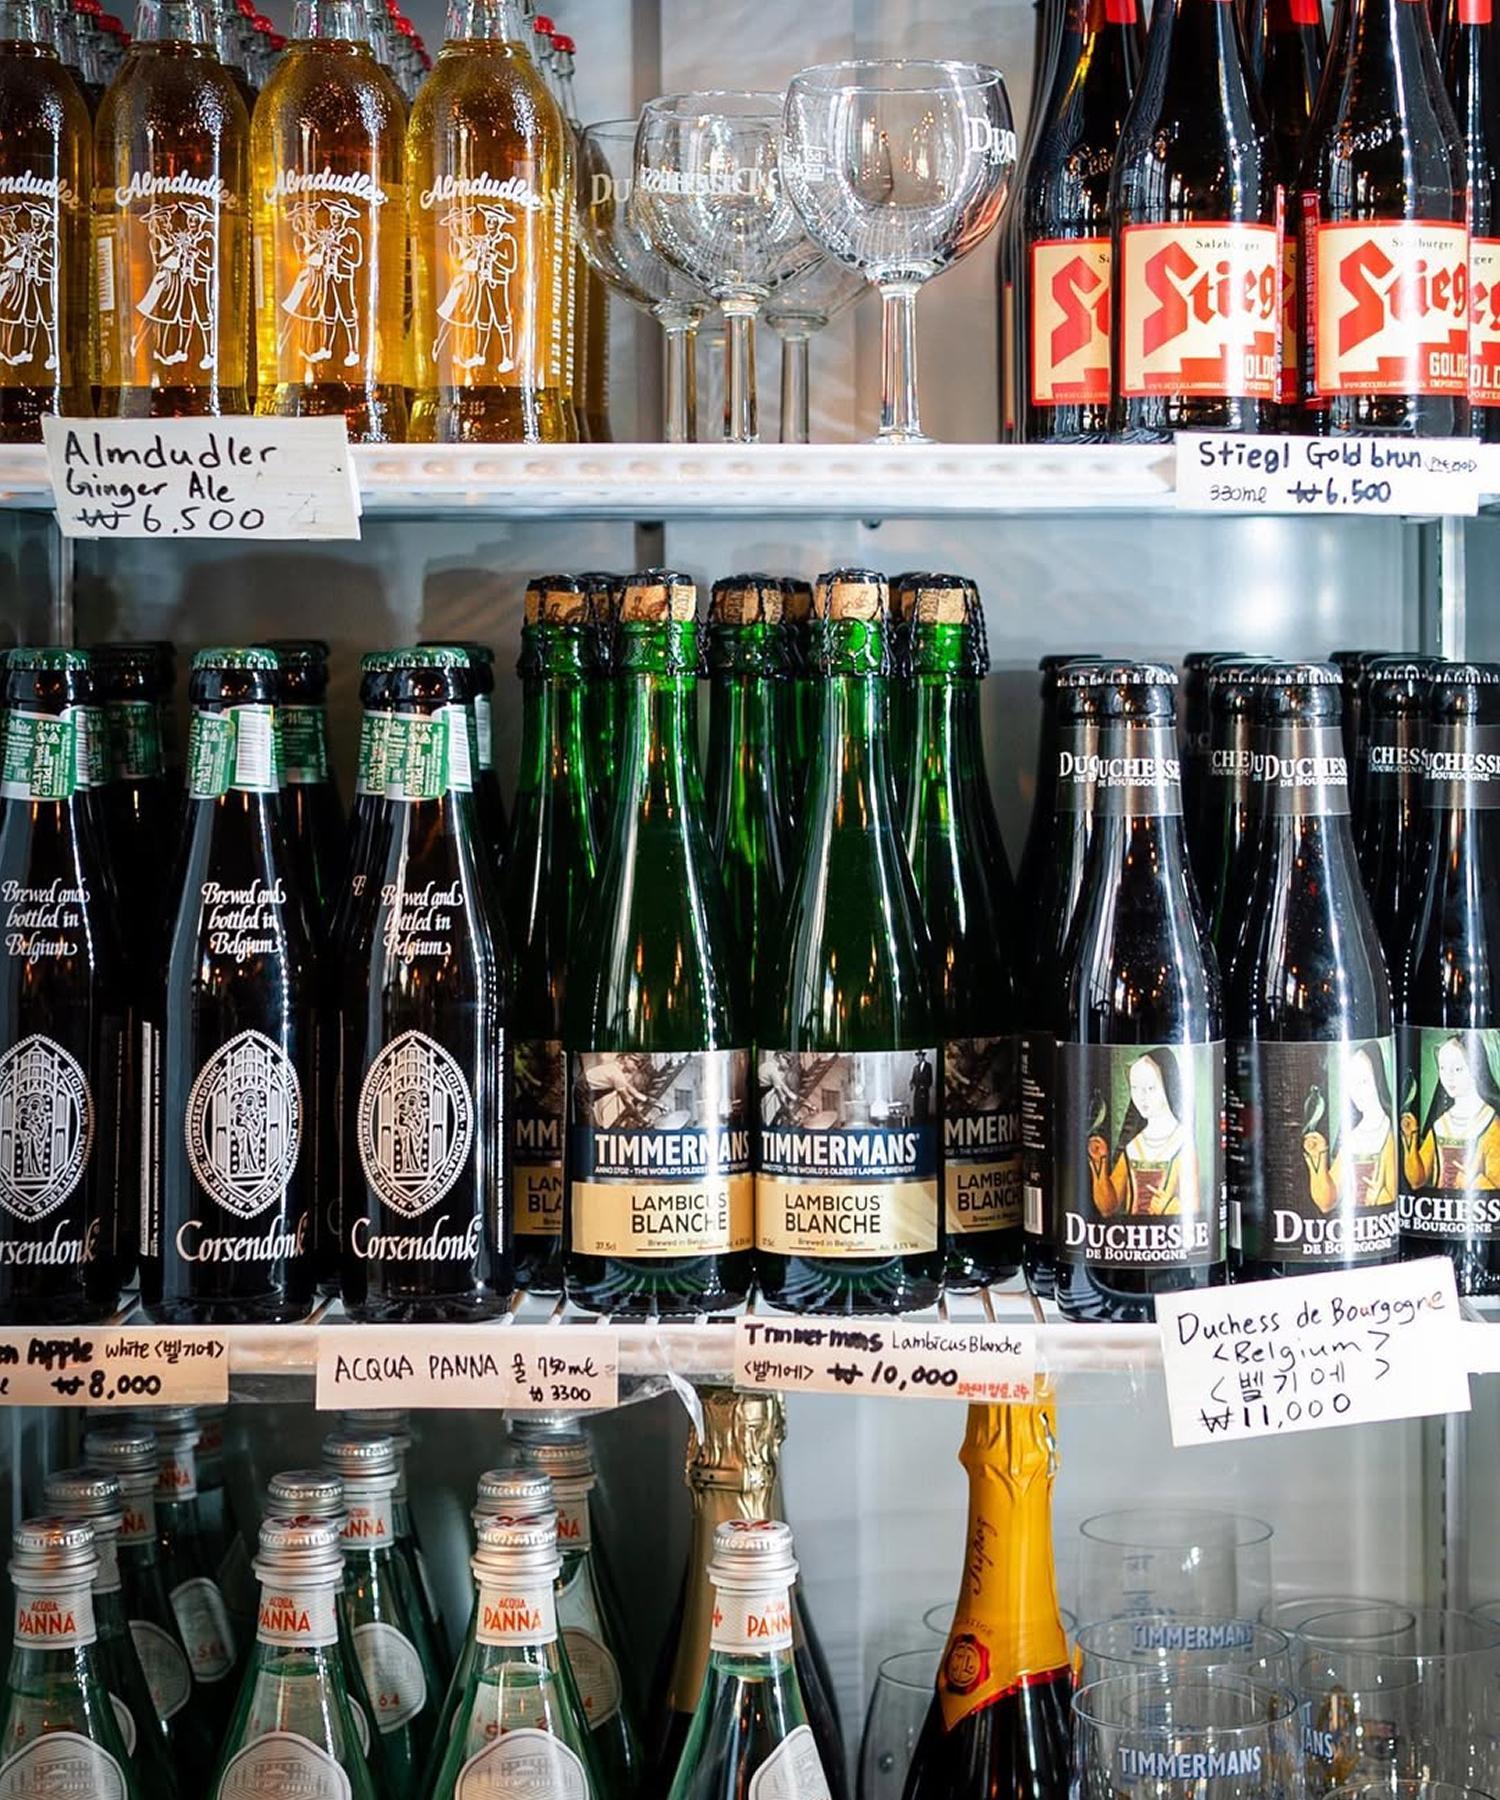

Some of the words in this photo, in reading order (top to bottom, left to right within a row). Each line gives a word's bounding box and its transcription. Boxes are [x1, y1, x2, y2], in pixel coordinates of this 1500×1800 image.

[65, 431, 278, 468] Almdudler
[1199, 441, 1289, 473] Stiegl
[1306, 442, 1361, 467] Gold
[66, 468, 169, 508] Ginger
[189, 471, 236, 503] Ale
[1, 879, 56, 903] Brewed
[201, 880, 261, 905] Brewed
[381, 880, 435, 906] Bwed
[431, 880, 463, 906] and
[6, 903, 66, 928] bottled
[63, 909, 79, 928] in
[208, 904, 261, 930] bottled
[384, 907, 438, 931] bttled
[435, 914, 451, 931] in
[5, 931, 78, 964] Belgium
[210, 930, 282, 963] Belgium
[383, 932, 451, 964] Belgium
[761, 1131, 919, 1166] TIMMERMANS
[632, 1193, 726, 1211] LAMBICS
[785, 1194, 880, 1212] LAMBICUS
[785, 1213, 881, 1234] BLANCHE
[1413, 1217, 1493, 1233] BOURGOGNE
[176, 1212, 308, 1262] Corsendonk
[352, 1214, 479, 1262] Corsendonk
[1303, 1243, 1322, 1255] DE
[1086, 1248, 1101, 1259] DE
[1105, 1247, 1188, 1261] BOURGOGNE
[1177, 1310, 1281, 1345] Duchess
[1296, 1302, 1322, 1327] de
[1332, 1289, 1447, 1326] Bourgogne
[27, 1337, 94, 1371] Apple
[105, 1338, 151, 1359] white
[335, 1354, 414, 1383] ACQUA
[429, 1354, 499, 1380] PANNA
[499, 1597, 526, 1610] ACQUA
[18, 1611, 77, 1635] PANNA
[484, 1608, 542, 1632] PANNA
[1117, 1746, 1262, 1778] TIMMERMANS
